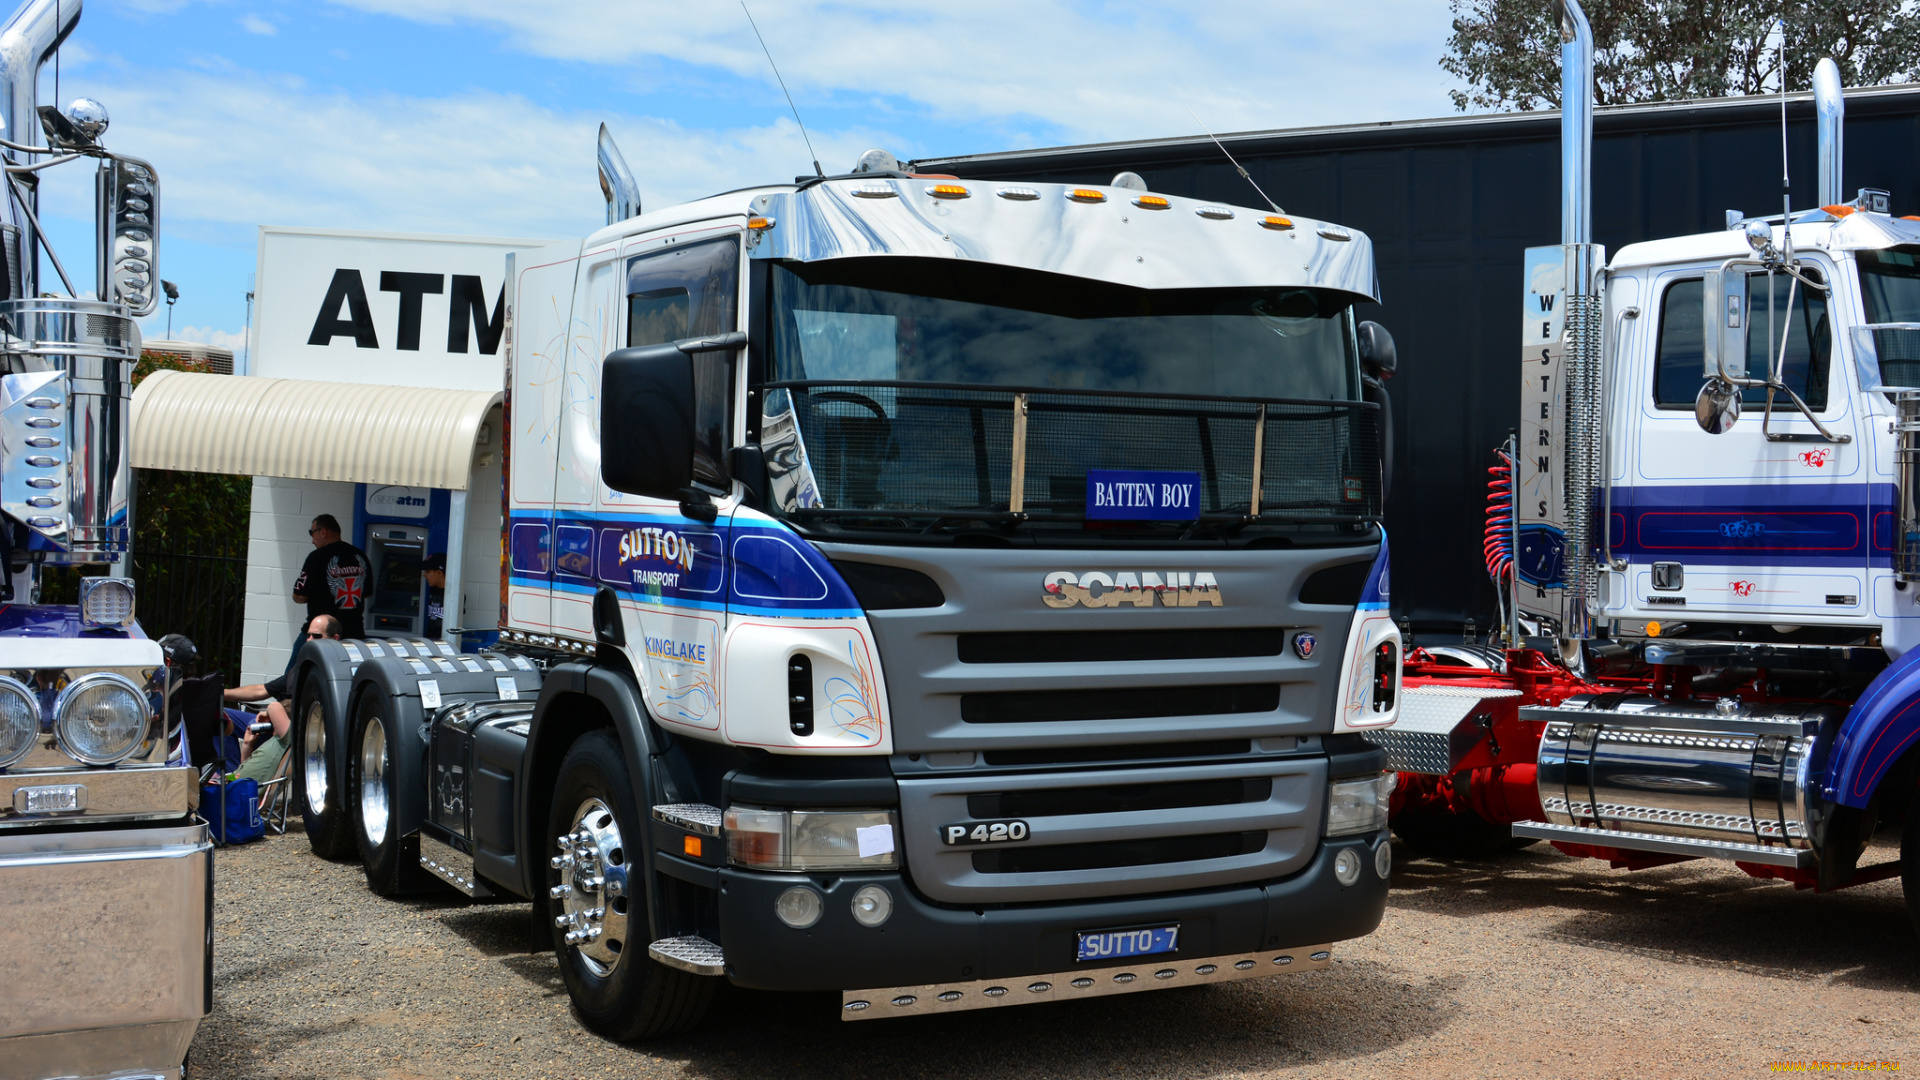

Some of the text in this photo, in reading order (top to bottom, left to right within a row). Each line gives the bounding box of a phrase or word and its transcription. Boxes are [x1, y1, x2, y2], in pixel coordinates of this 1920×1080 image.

[307, 268, 506, 356] ATM
[1537, 294, 1555, 598] WESTERN STAR
[1095, 482, 1193, 508] BATTEN BOY
[619, 527, 695, 573] SUTTON
[632, 569, 680, 588] TRANSPORT
[1042, 571, 1224, 609] SCANIA
[651, 595, 662, 605] VIC
[645, 636, 706, 663] KINGLAKE
[948, 821, 1027, 844] P 420
